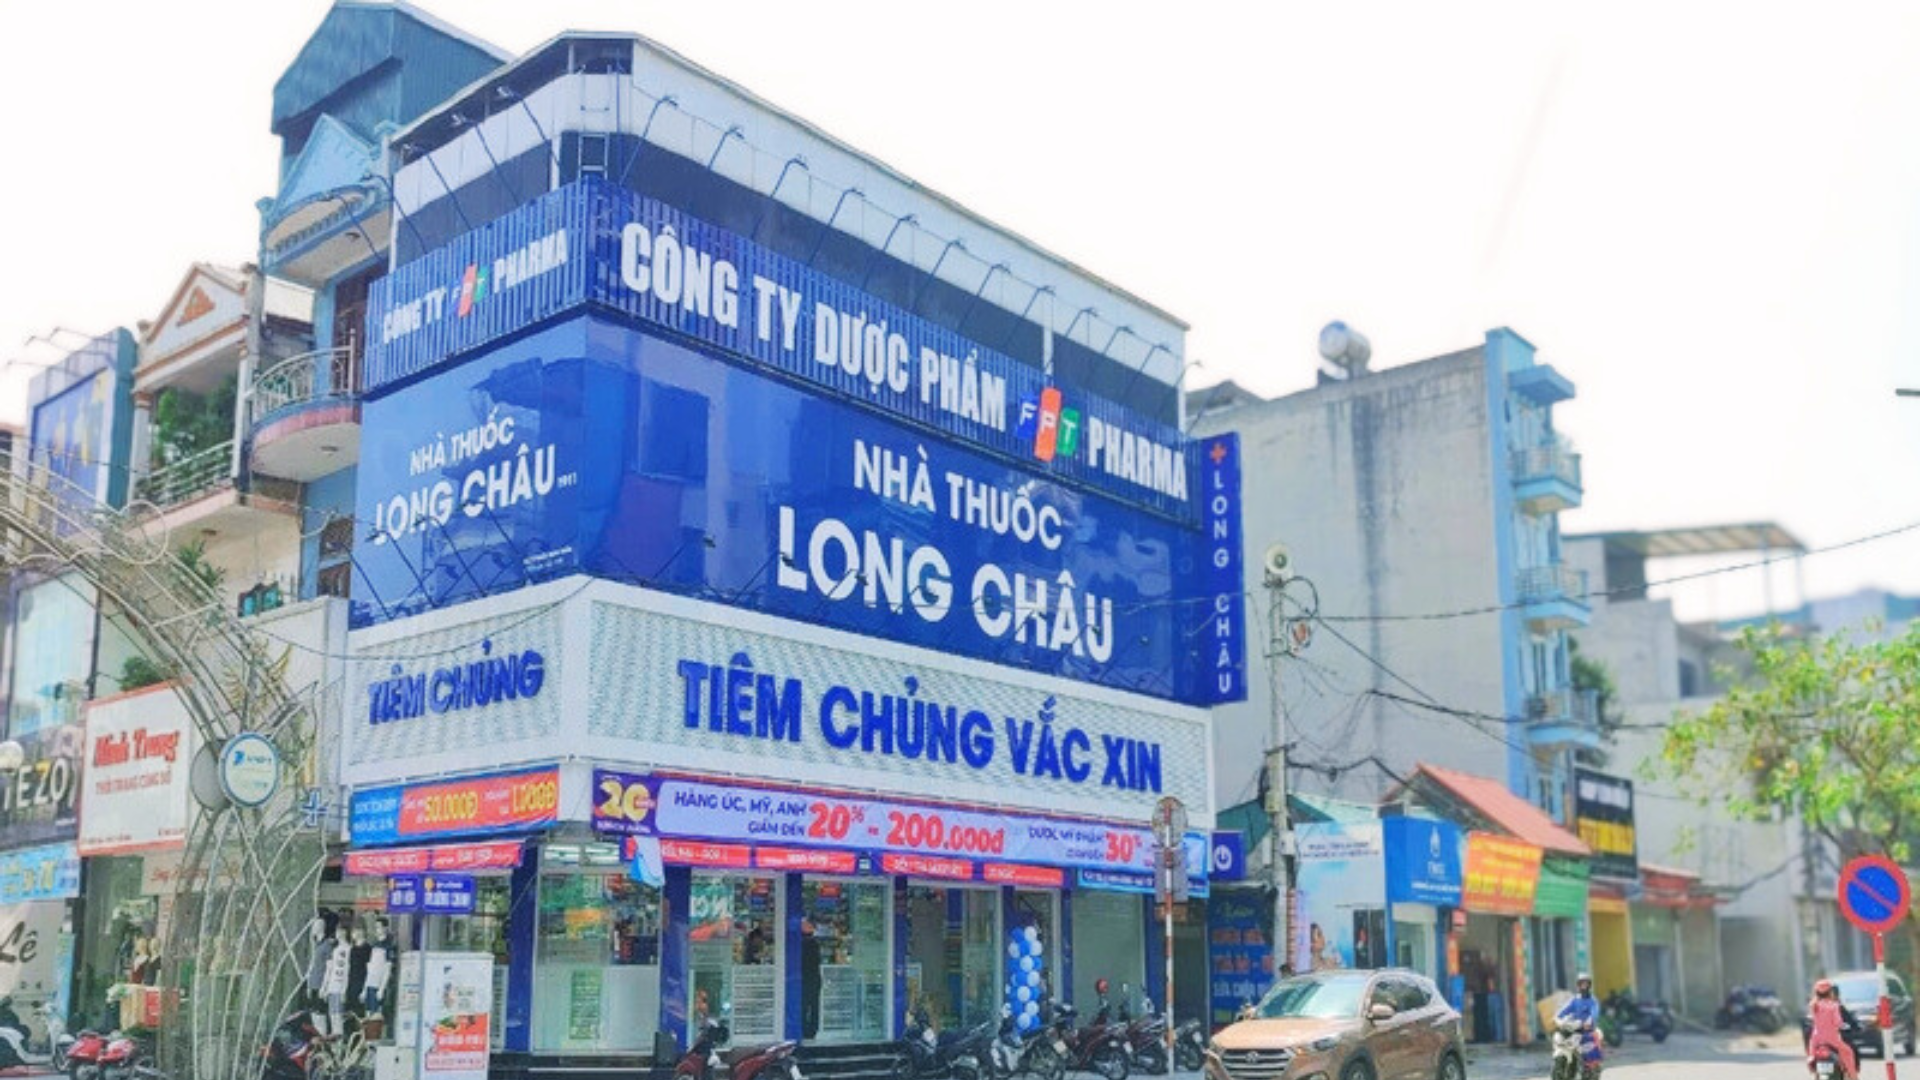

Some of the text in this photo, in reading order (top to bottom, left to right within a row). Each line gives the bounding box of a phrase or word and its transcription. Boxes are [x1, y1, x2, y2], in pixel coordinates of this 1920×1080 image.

[383, 299, 423, 345] CÔNG
[426, 286, 447, 325] TY
[493, 228, 568, 294] PHARMA
[621, 221, 1188, 501] CÔNG TY DƯỢC PHẨM FPT PHARMA
[374, 480, 454, 546] LONG
[461, 443, 556, 518] CHÂU
[410, 405, 515, 476] NHÀ THUỐC
[854, 440, 1063, 551] NHÀ THUỐC
[777, 505, 1113, 663] LONG CHÂU
[1211, 469, 1233, 694] LONG CHÂU
[368, 638, 545, 727] TIÊM CHỦNG
[679, 652, 1163, 793] TIÊM CHỦNG VẮC XIN
[674, 790, 719, 811] HÀNG
[776, 801, 807, 817] ANH
